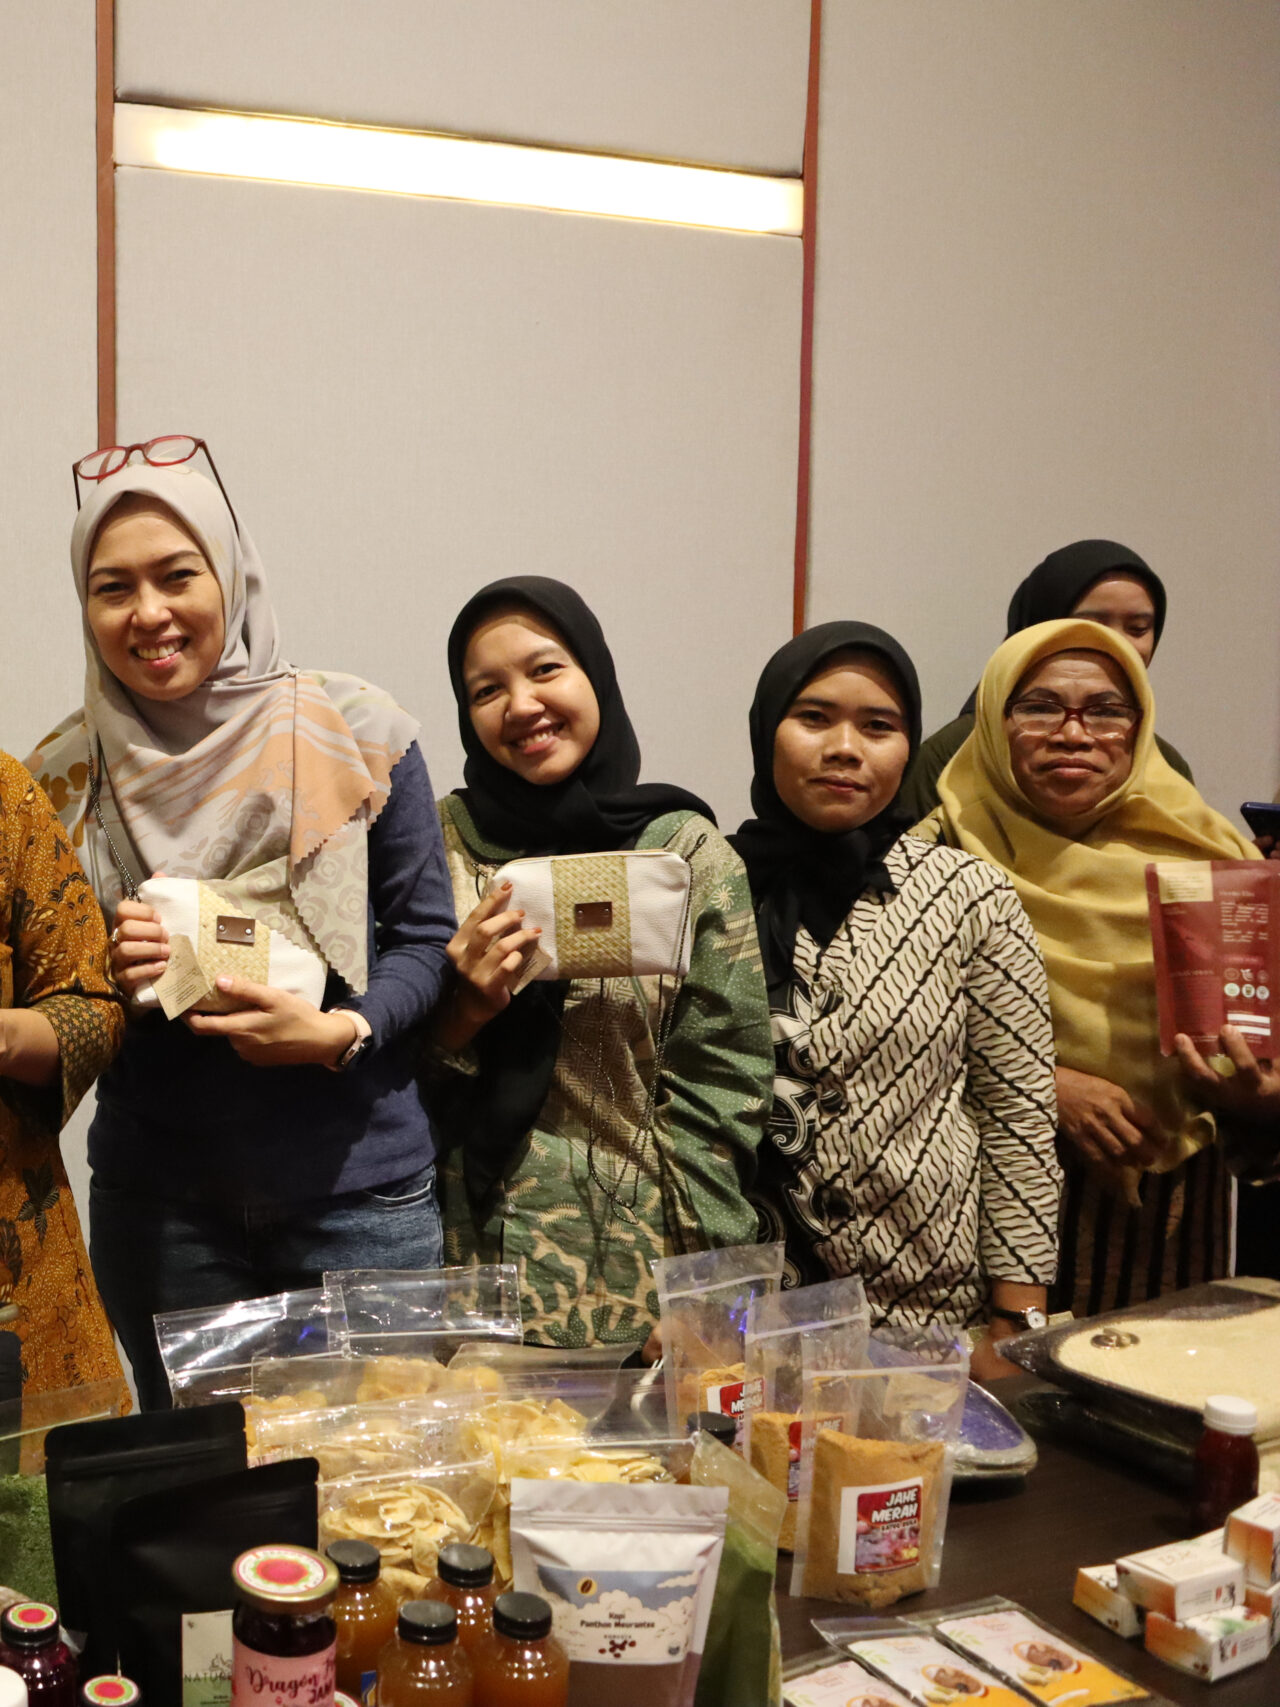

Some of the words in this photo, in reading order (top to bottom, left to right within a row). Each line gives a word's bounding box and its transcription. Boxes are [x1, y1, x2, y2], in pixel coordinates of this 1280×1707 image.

[886, 1488, 918, 1507] JAHE
[871, 1503, 918, 1523] MERAH
[245, 1664, 319, 1698] Dragon
